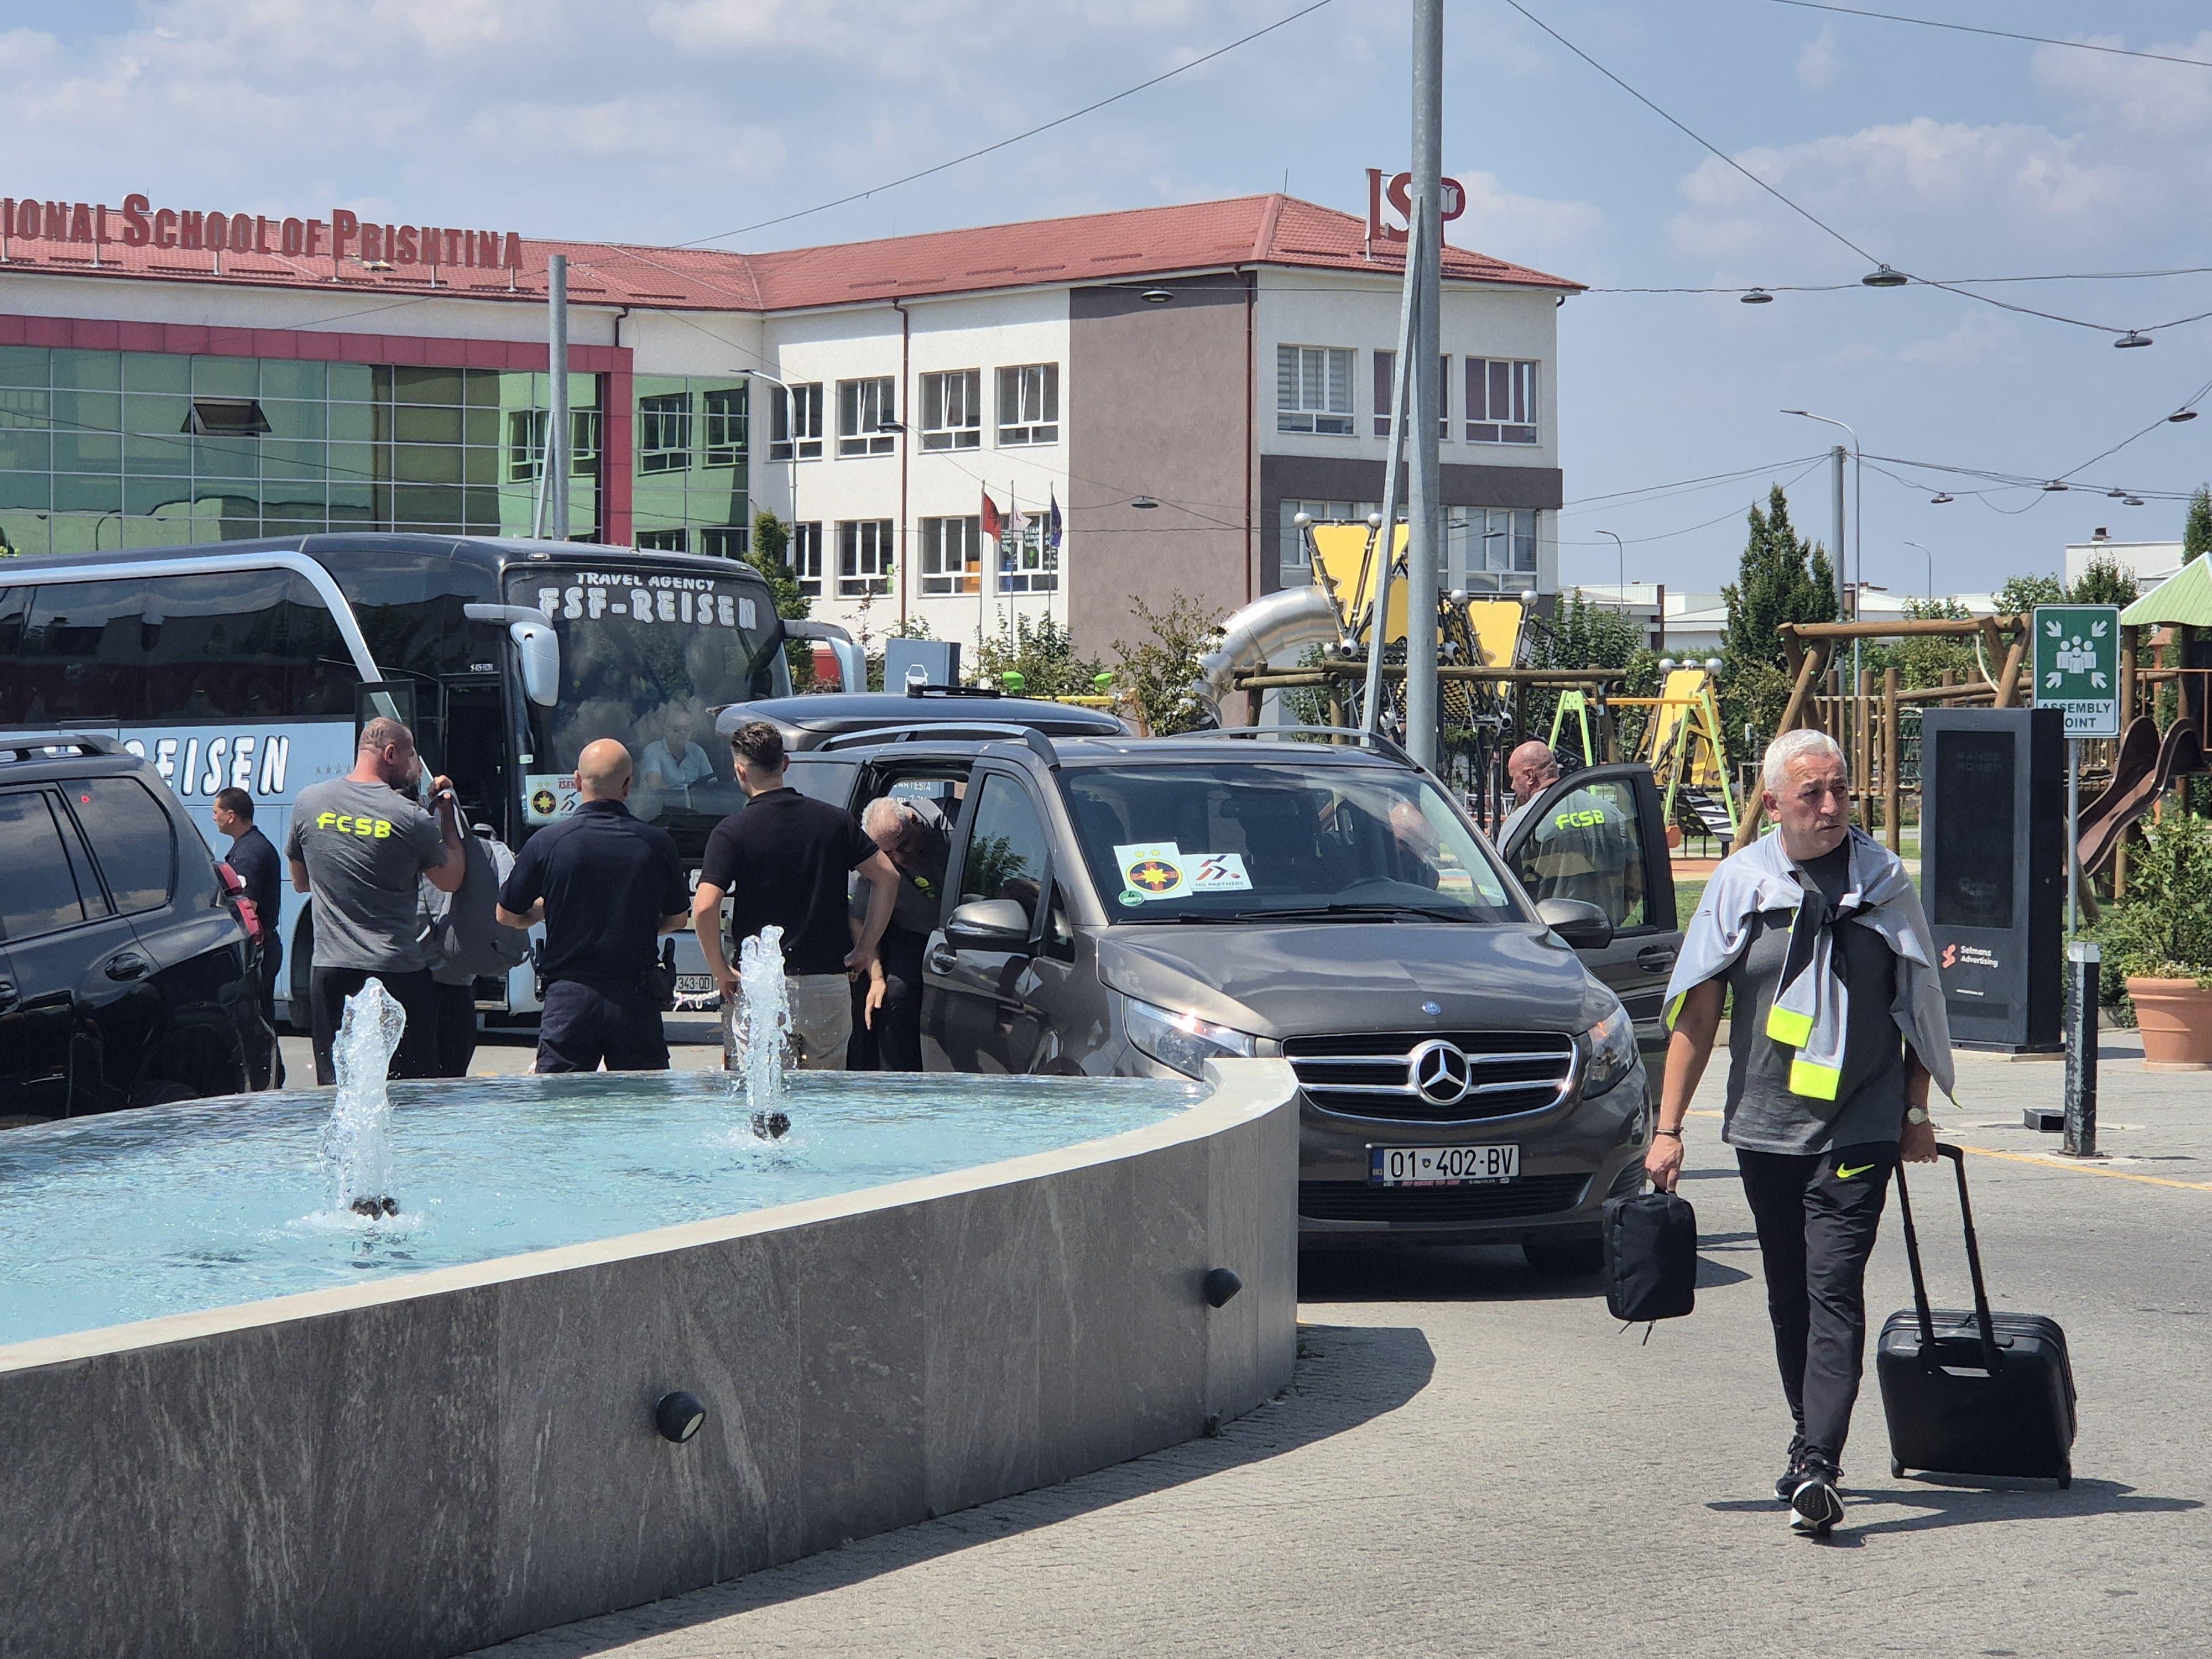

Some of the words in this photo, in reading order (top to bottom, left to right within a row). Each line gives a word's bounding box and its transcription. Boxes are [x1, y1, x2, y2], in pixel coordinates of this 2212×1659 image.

[576, 572, 643, 586] TRAVEL
[648, 575, 716, 591] AGENCY
[538, 587, 757, 630] FSF-REISEN
[2065, 718, 2096, 728] OINT
[316, 811, 392, 838] FCSB
[1554, 809, 1605, 830] FCSB
[1960, 945, 1992, 957] Selmans
[1960, 956, 1999, 968] Advertising
[1391, 1151, 1416, 1178] 01
[1436, 1147, 1514, 1177] 402-BV
